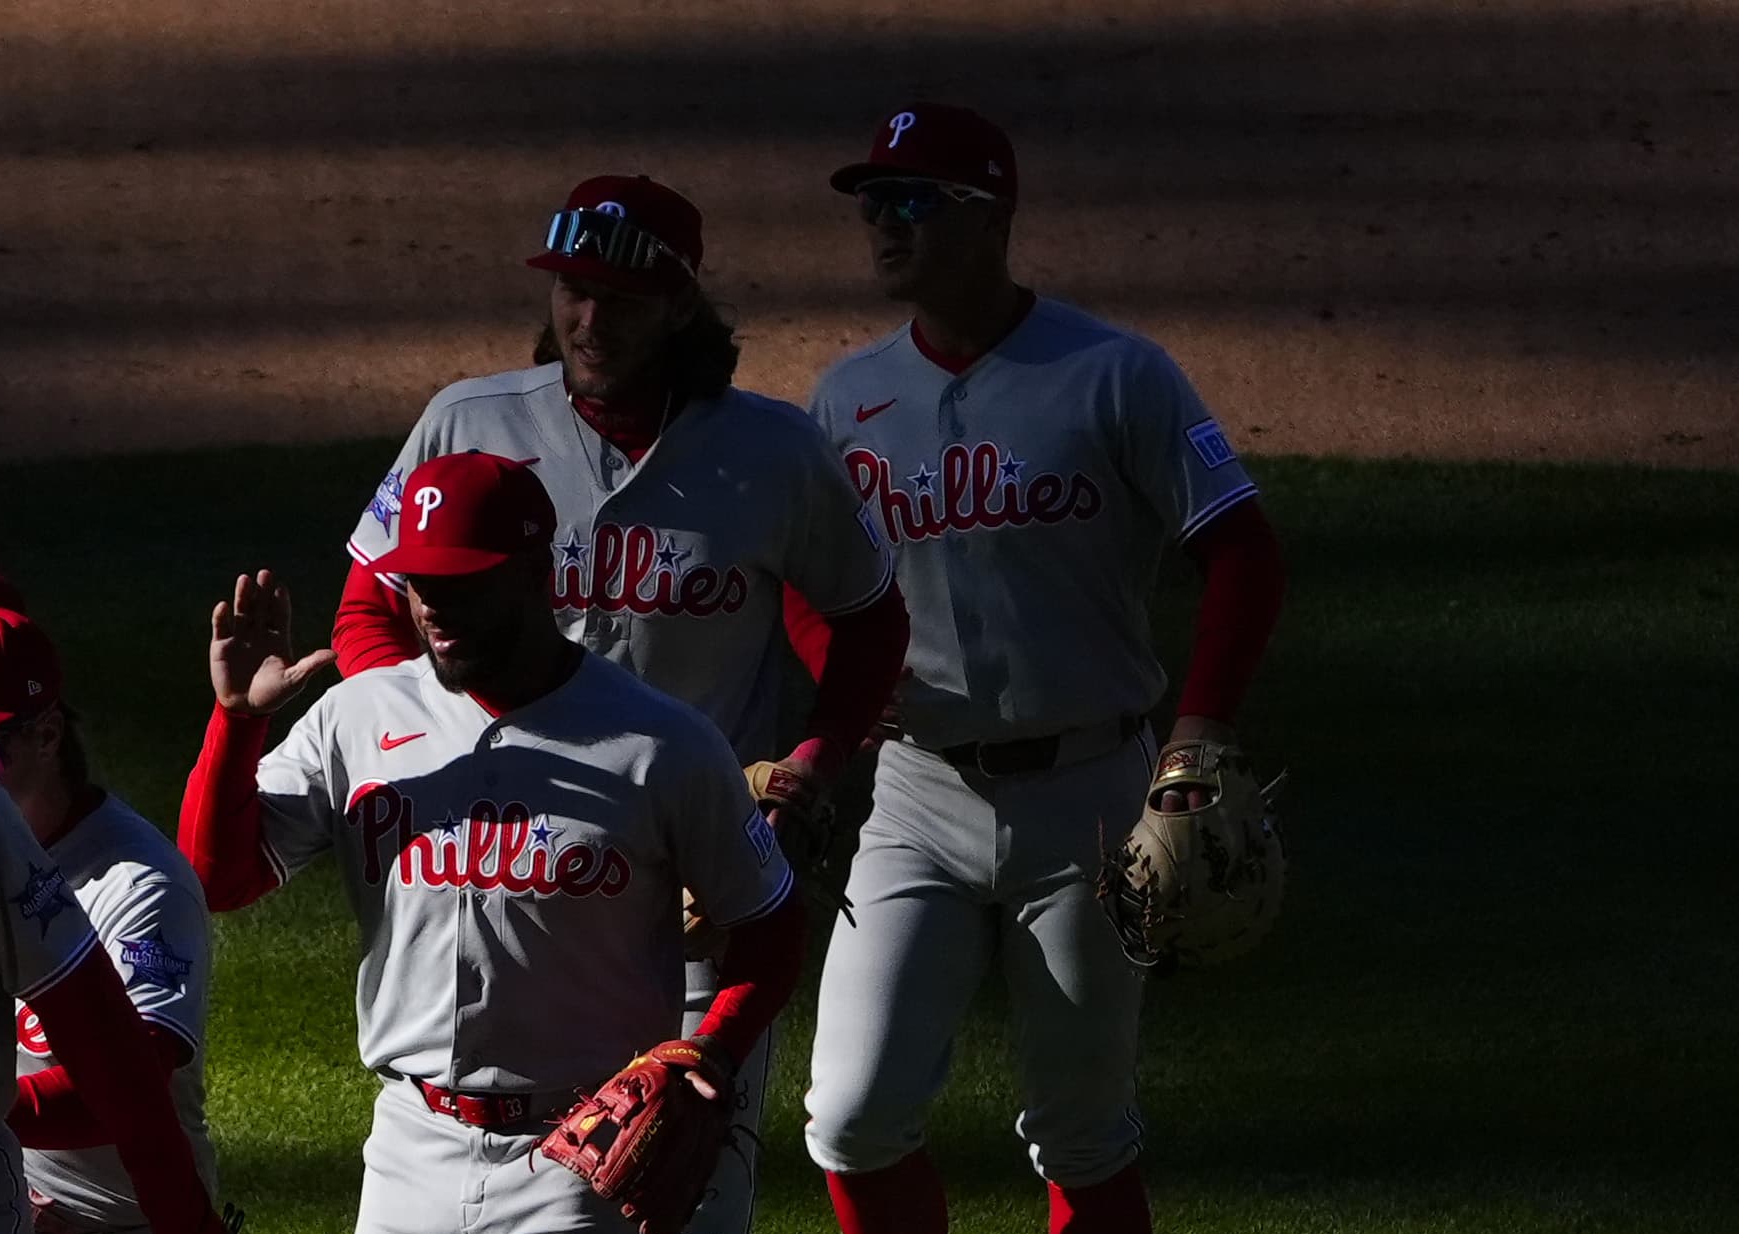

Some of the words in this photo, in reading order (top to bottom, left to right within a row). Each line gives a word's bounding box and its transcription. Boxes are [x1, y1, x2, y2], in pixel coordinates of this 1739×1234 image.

[888, 111, 917, 149] P
[414, 486, 444, 532] P
[843, 440, 1101, 544] Phillies
[549, 523, 747, 618] illies
[344, 781, 633, 900] Phillies
[505, 1097, 523, 1118] 33
